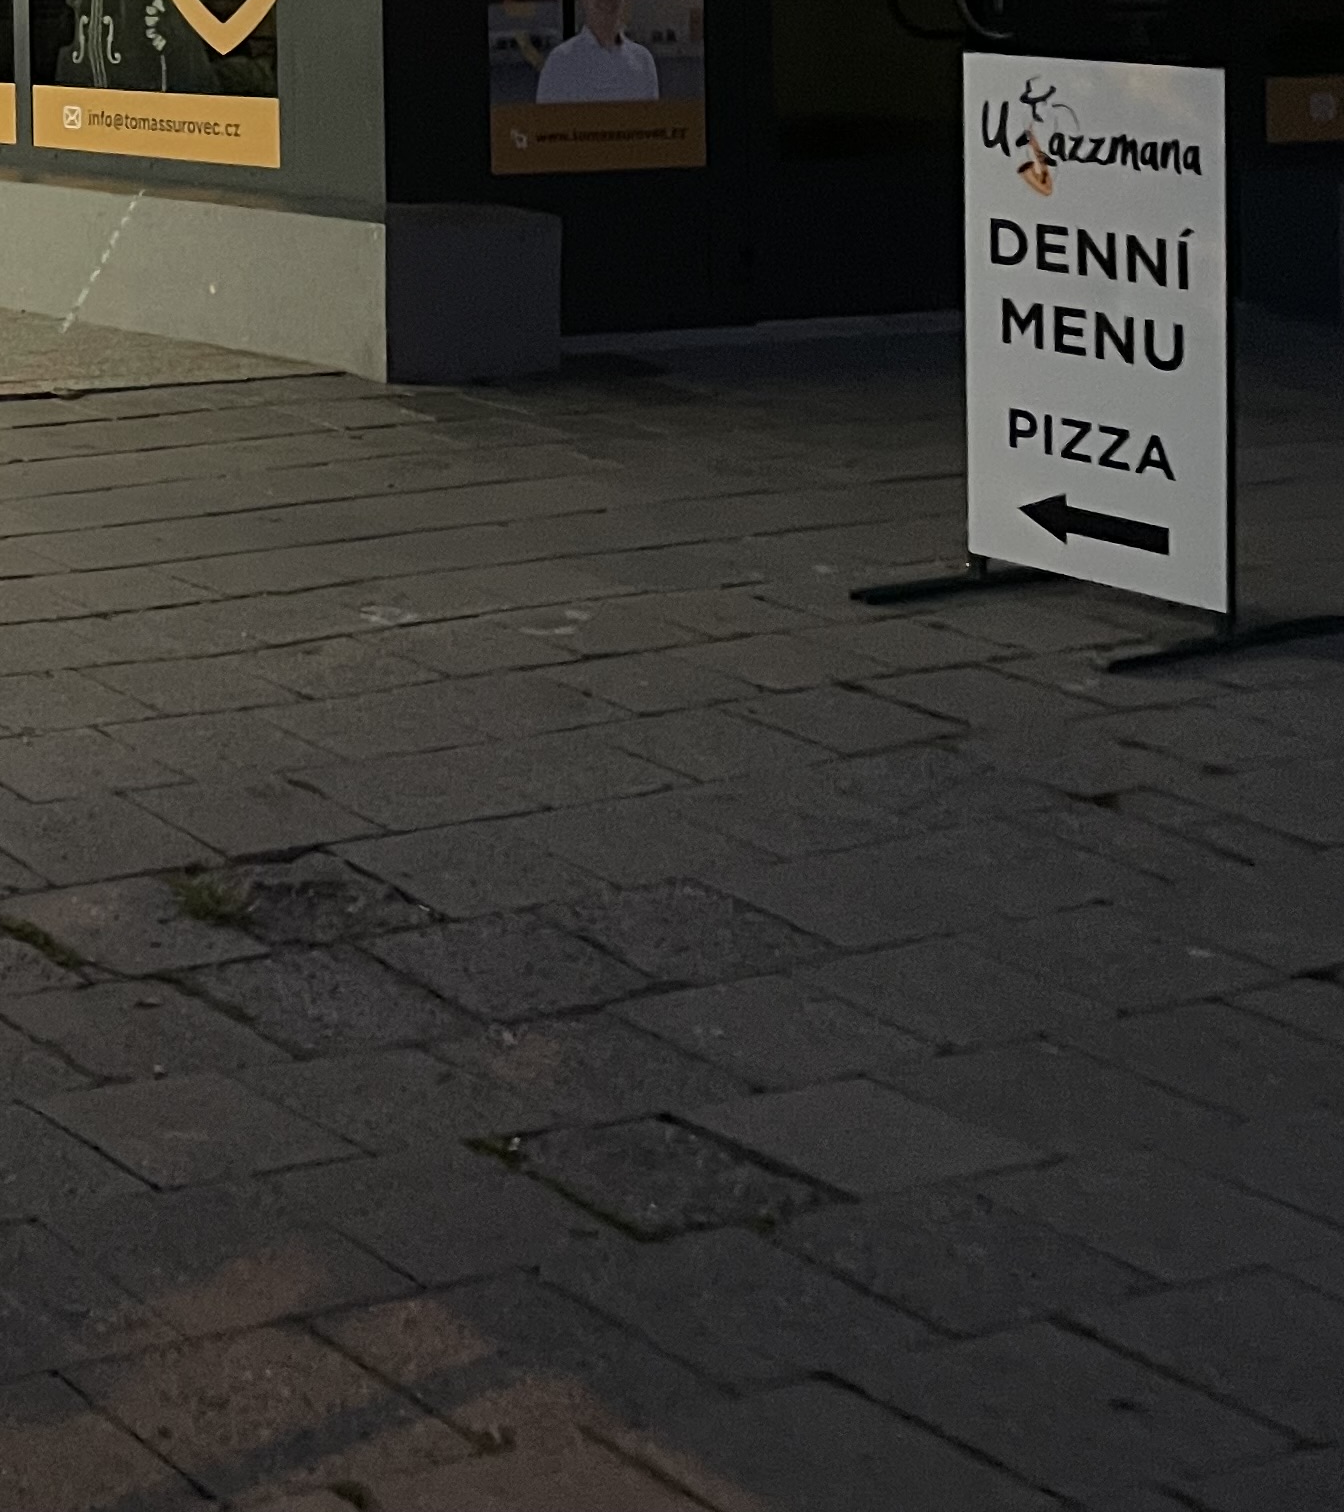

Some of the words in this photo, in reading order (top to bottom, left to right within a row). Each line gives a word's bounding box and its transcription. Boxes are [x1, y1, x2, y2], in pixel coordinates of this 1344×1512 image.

[87, 109, 241, 138] info@tomassurovec.cz
[989, 217, 1195, 291] DENNÍ
[1001, 297, 1185, 372] MENU
[1008, 408, 1177, 482] PIZZA
